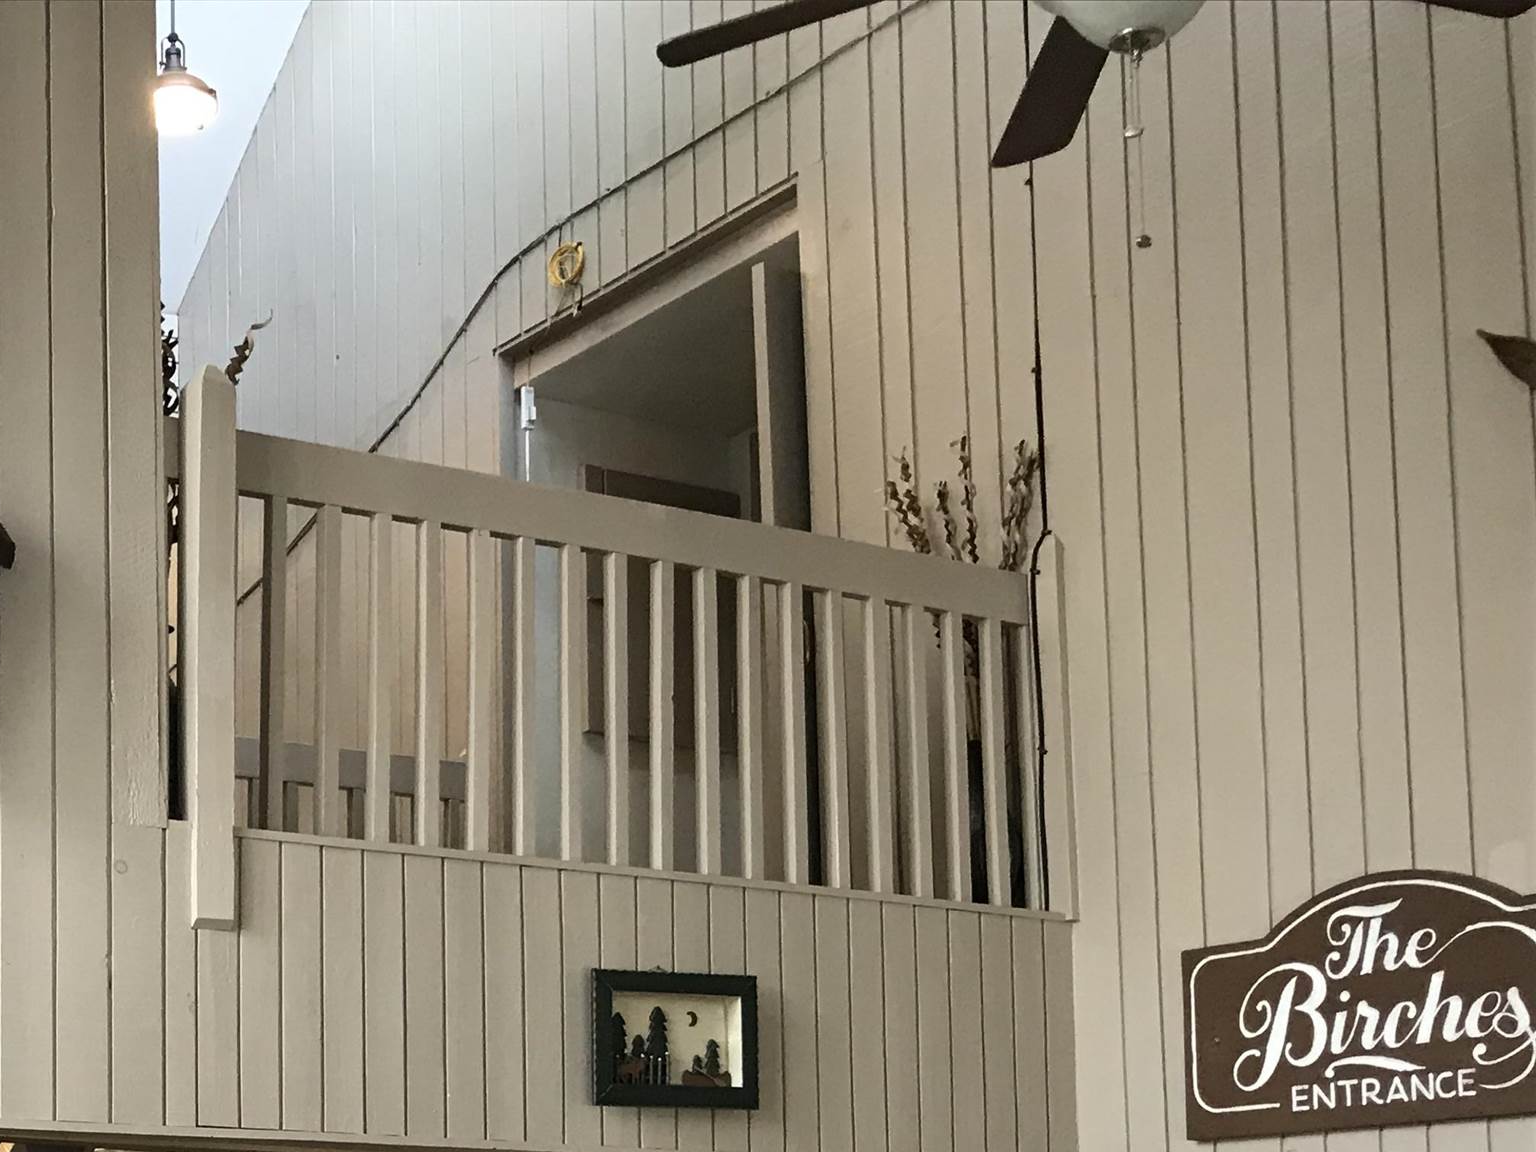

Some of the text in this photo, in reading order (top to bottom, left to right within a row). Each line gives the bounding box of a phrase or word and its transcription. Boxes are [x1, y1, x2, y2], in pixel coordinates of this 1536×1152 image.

[1325, 897, 1437, 980] The
[1233, 962, 1536, 1092] Birches
[1291, 1068, 1477, 1112] ENTRANCE
